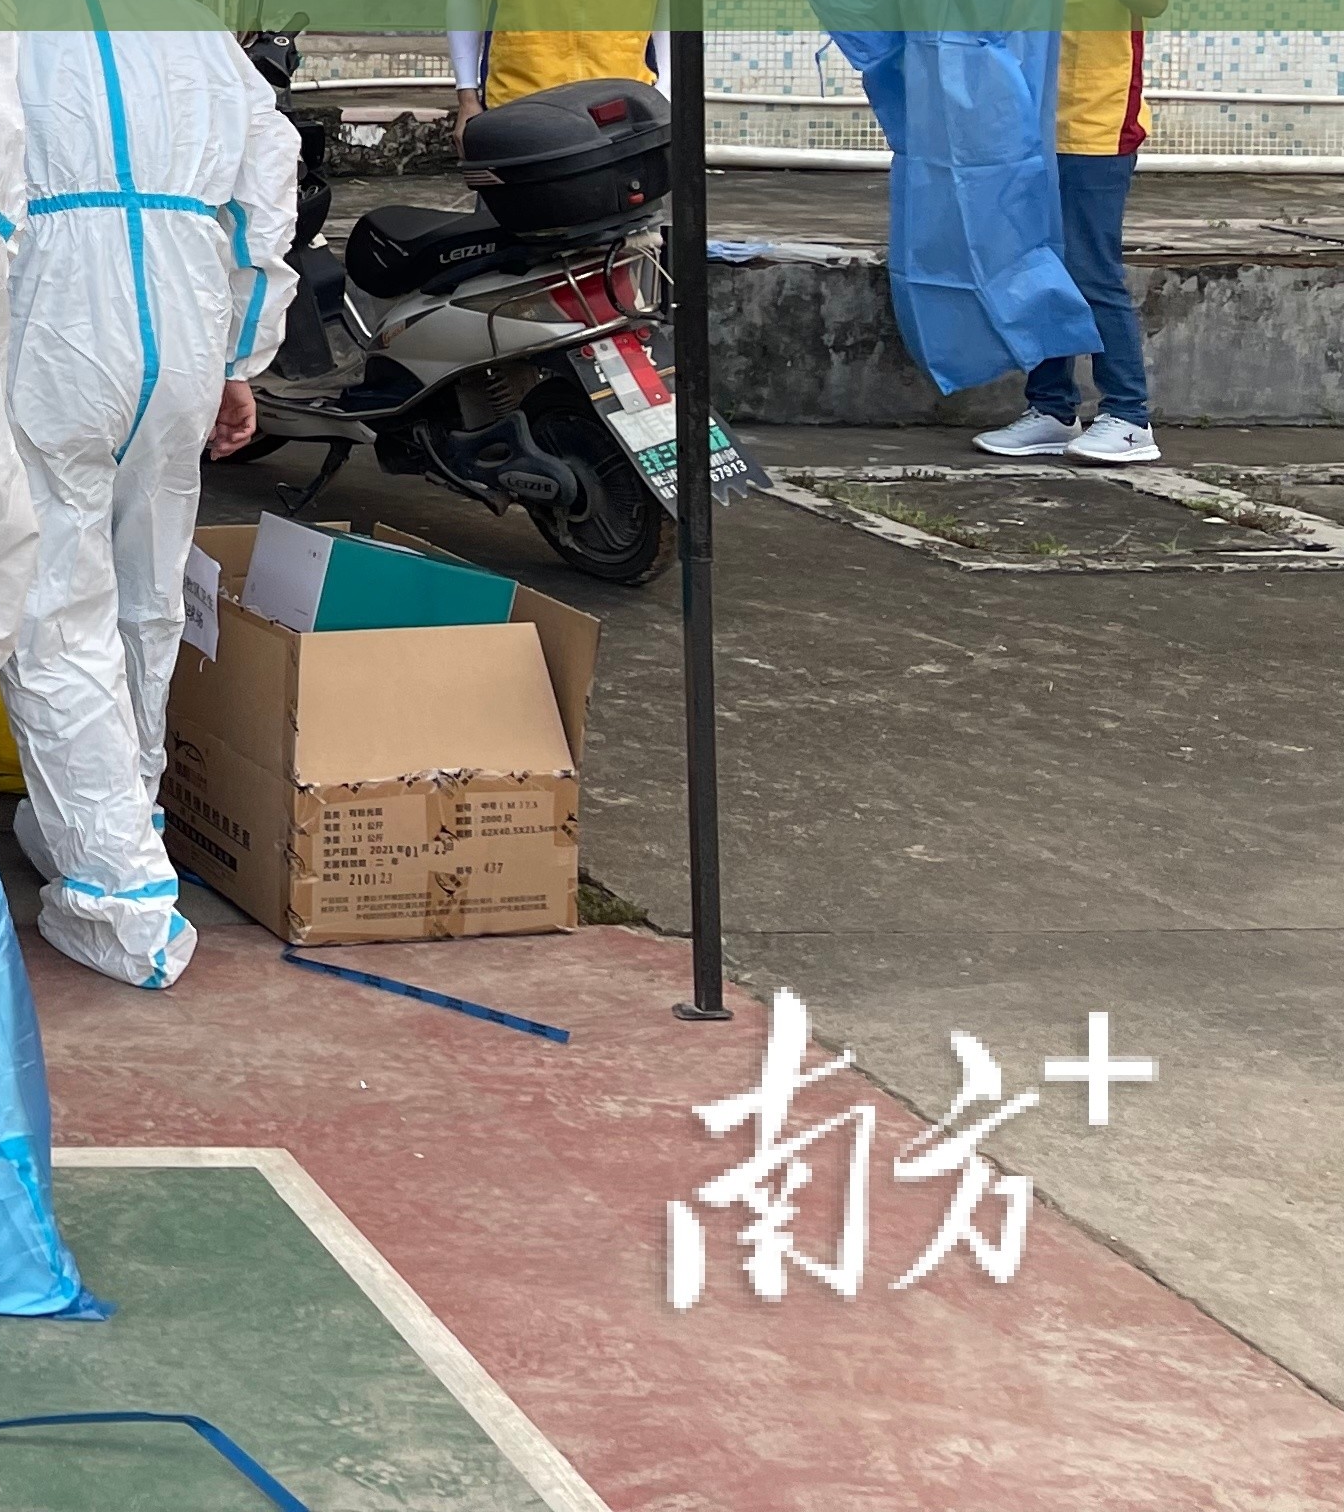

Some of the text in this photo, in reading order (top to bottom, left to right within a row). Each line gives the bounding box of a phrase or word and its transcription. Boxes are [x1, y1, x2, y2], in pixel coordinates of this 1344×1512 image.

[439, 243, 496, 264] LEIZHI
[352, 822, 362, 831] 14
[352, 834, 362, 843] 13
[484, 863, 504, 875] 437
[349, 872, 393, 886] 210123
